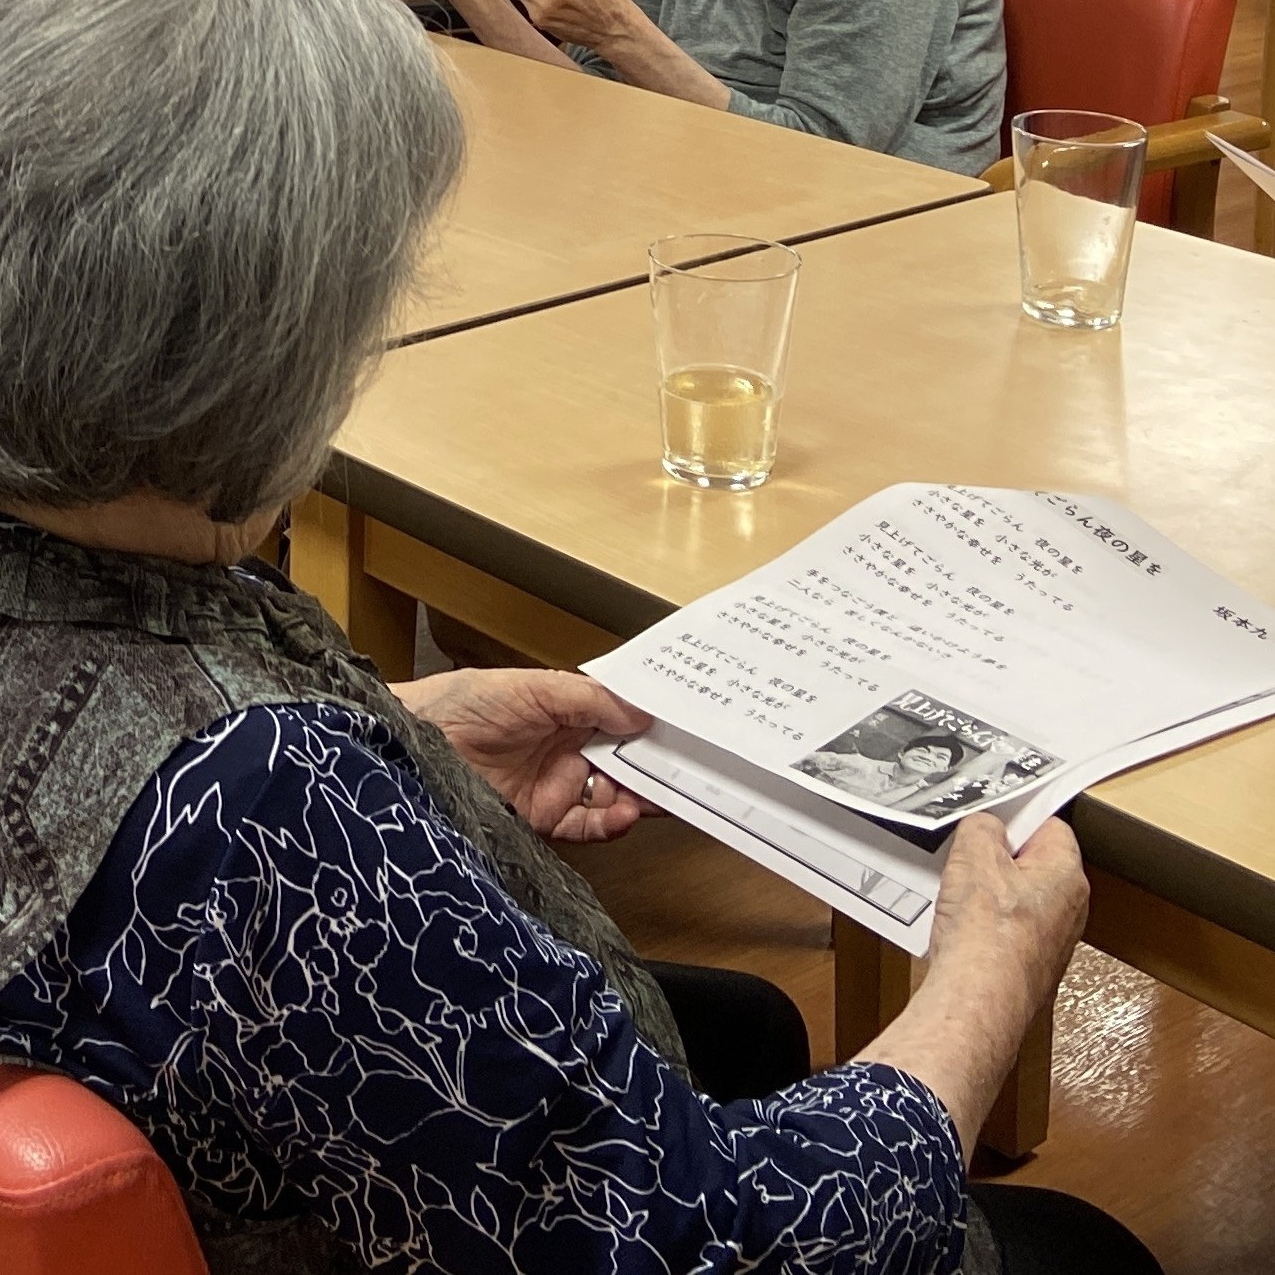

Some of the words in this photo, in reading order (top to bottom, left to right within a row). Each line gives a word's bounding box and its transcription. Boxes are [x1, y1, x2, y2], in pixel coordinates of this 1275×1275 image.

[858, 533, 917, 576] 小さな星を
[924, 581, 990, 618] 小さな光が
[874, 520, 956, 581] 見上げてごらん
[965, 586, 1015, 616] 夜の星を
[911, 498, 1003, 566] ささやかな幸せを
[1014, 573, 1075, 612] うたってる
[927, 489, 986, 528] 小さな星を
[995, 534, 1058, 578] 小さな光が
[1034, 536, 1084, 576] 夜の星を
[733, 601, 792, 631] 小さな星を
[800, 633, 867, 664] 小さな光が
[786, 578, 834, 606] 二人なら
[842, 544, 933, 608] ささやかな幸せを
[945, 611, 1006, 643] うたってる
[659, 644, 718, 677] 小さな星を
[726, 677, 792, 710] 小さな光が
[677, 632, 759, 676] 見上げてごらん
[767, 677, 818, 705] 夜の星を
[716, 610, 808, 658] ささやかな幸せを
[820, 659, 880, 693] うたってる
[642, 657, 734, 707] ささやかな幸せを
[744, 708, 805, 742] うたってる
